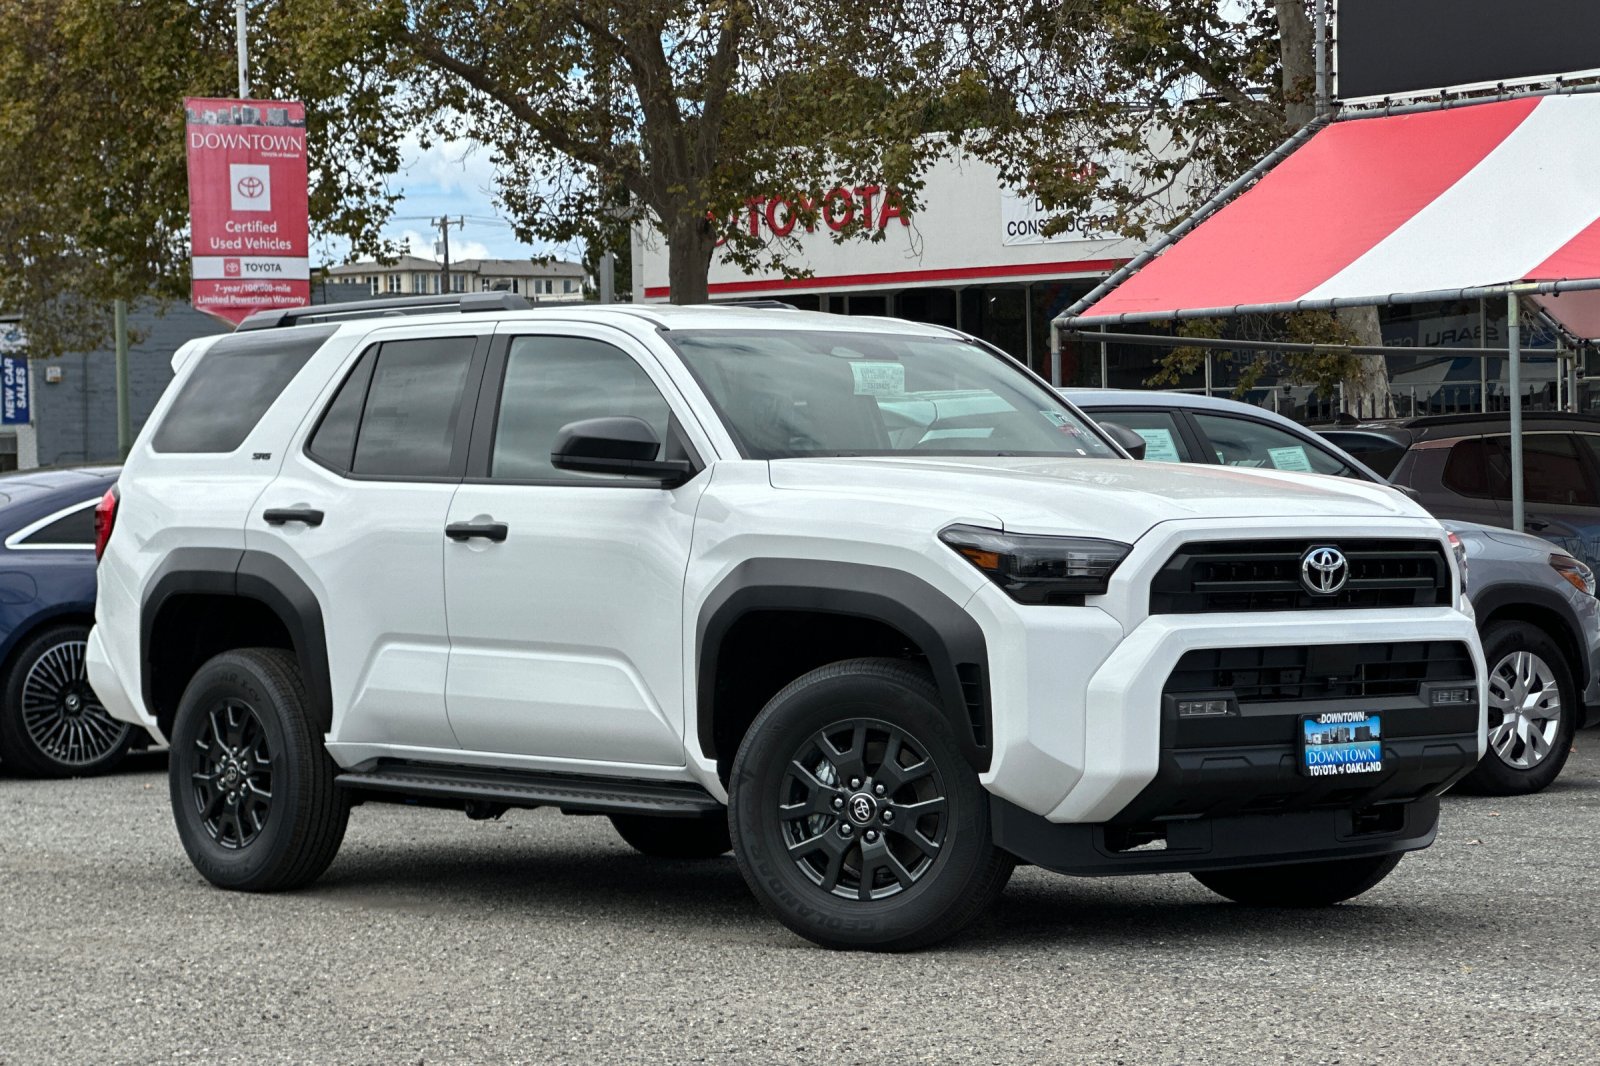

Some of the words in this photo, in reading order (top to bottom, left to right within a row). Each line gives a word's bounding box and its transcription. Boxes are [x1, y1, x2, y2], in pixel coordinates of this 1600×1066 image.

[191, 132, 302, 151] DOWNTOWN
[225, 220, 277, 233] Certified
[210, 237, 242, 250] Used
[245, 237, 292, 250] Vehicles
[244, 263, 282, 272] TOYOTA
[198, 295, 229, 304] Limited
[230, 295, 272, 304] Powertrain
[273, 295, 305, 305] Warranty
[4, 358, 14, 386] CAR
[16, 367, 26, 409] SALES
[5, 388, 15, 418] NEW
[1321, 711, 1365, 724] DOWNTOWN
[1308, 748, 1376, 764] DOWNTOWN
[1309, 763, 1338, 776] TOYOTA
[1346, 761, 1382, 774] OAKLAND
